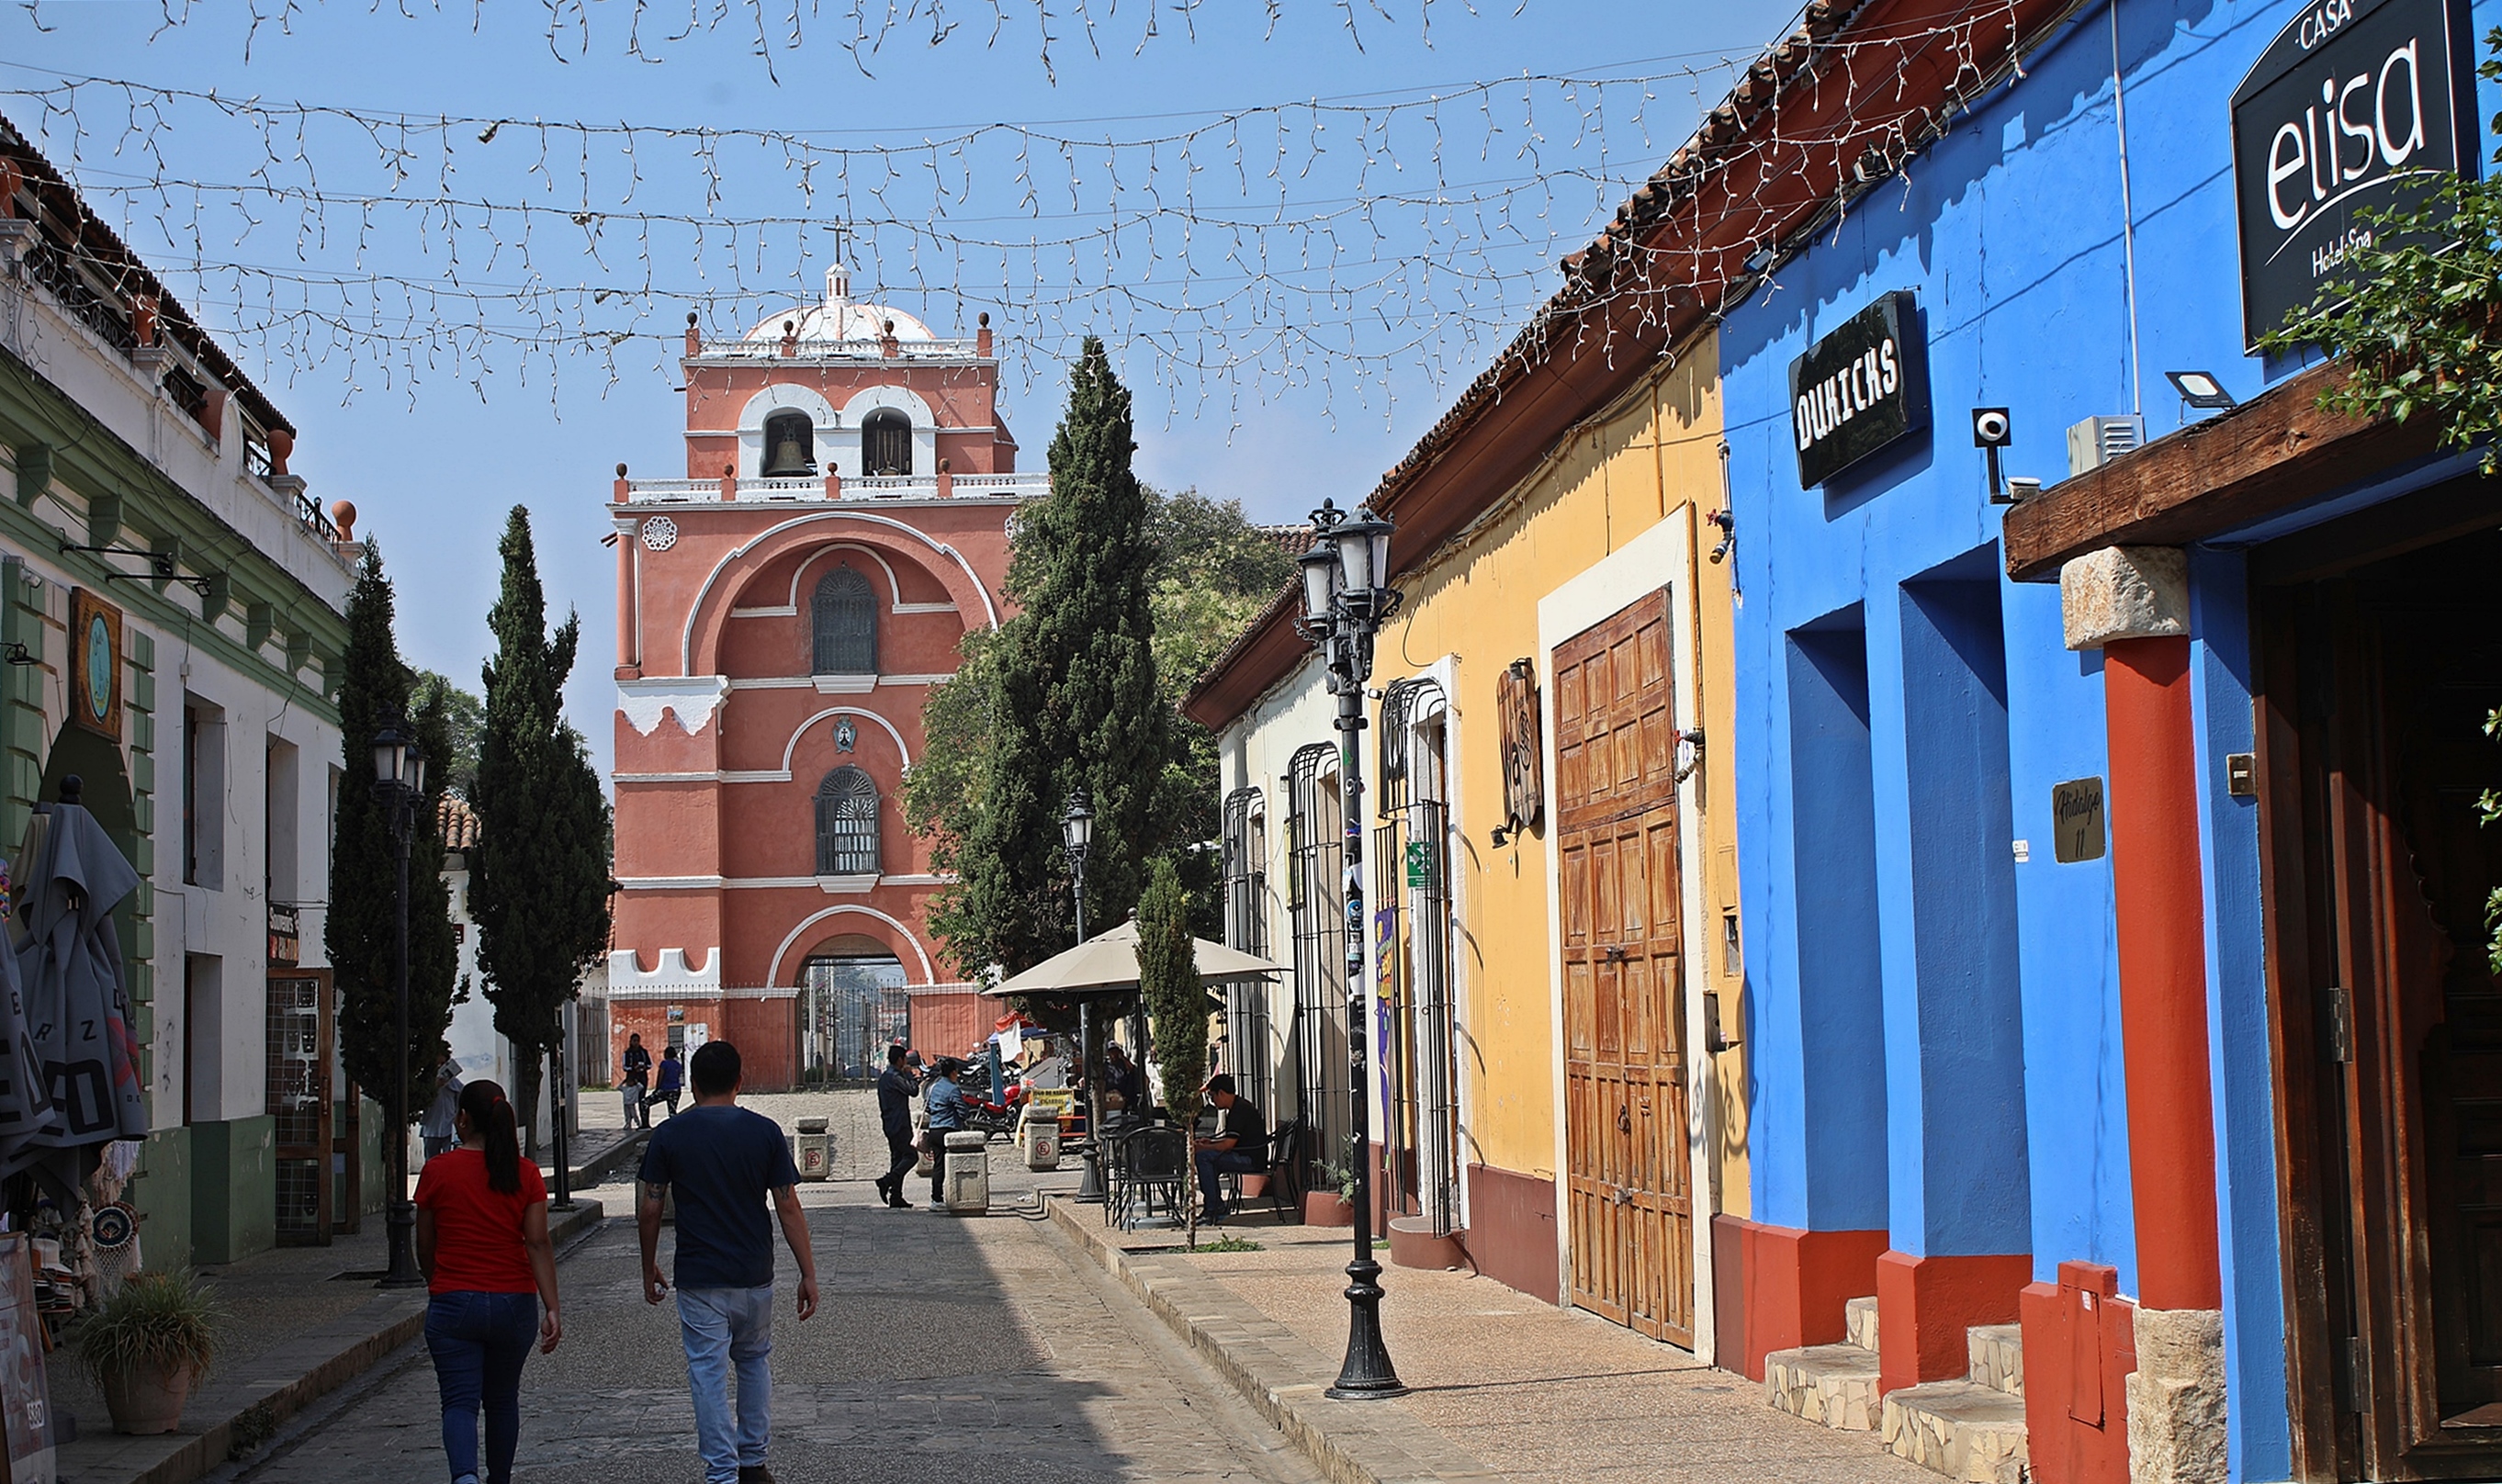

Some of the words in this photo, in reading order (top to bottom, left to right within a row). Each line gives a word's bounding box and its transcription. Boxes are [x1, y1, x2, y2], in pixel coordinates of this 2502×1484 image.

[2300, 0, 2352, 50] CASA
[2267, 37, 2425, 230] elisa
[2312, 234, 2344, 277] Hotel
[1797, 338, 1899, 452] DUKICKS
[2055, 786, 2102, 825] Hidalgo
[2075, 827, 2086, 858] 11
